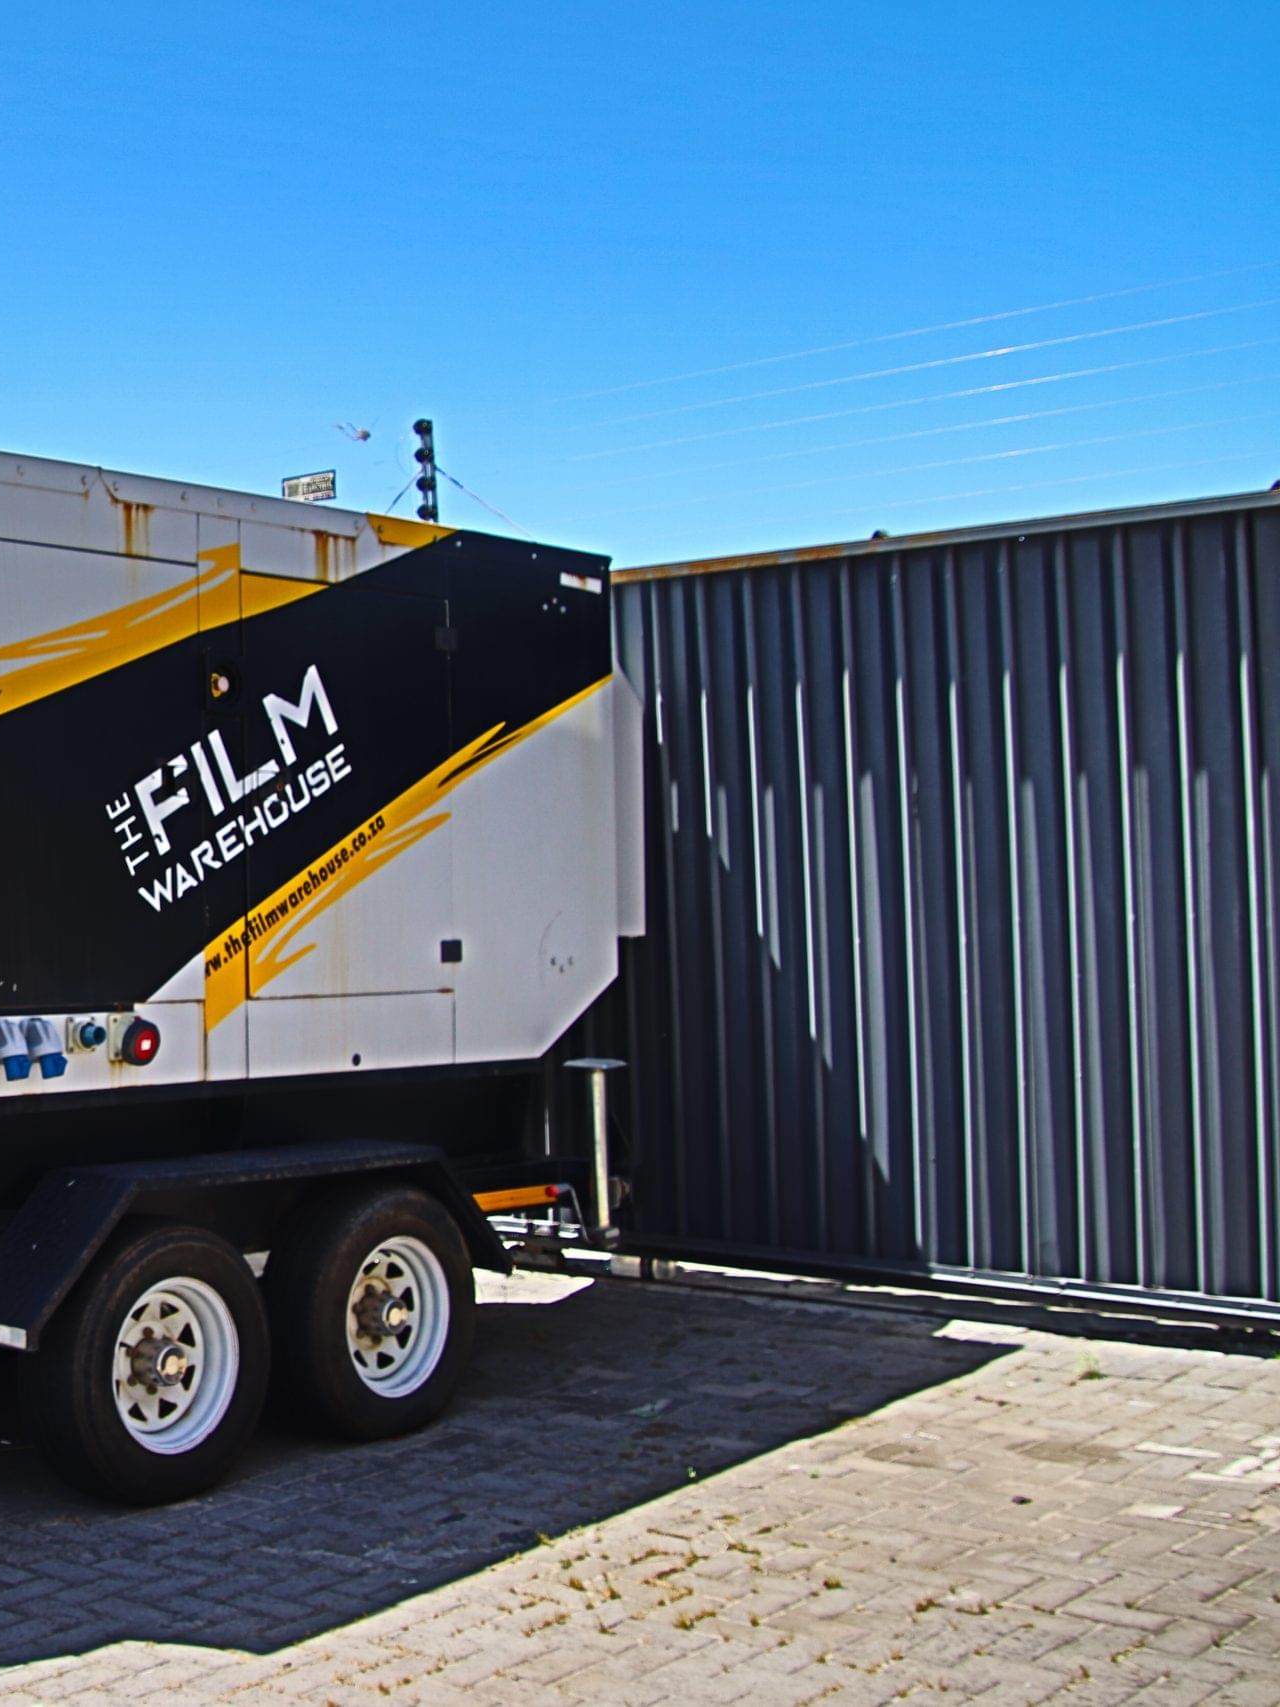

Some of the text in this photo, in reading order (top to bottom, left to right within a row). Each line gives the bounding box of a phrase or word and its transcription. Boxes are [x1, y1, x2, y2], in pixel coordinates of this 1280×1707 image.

[106, 792, 150, 876] THE
[133, 664, 339, 856] FILM
[137, 743, 352, 912] WAREHOUSE
